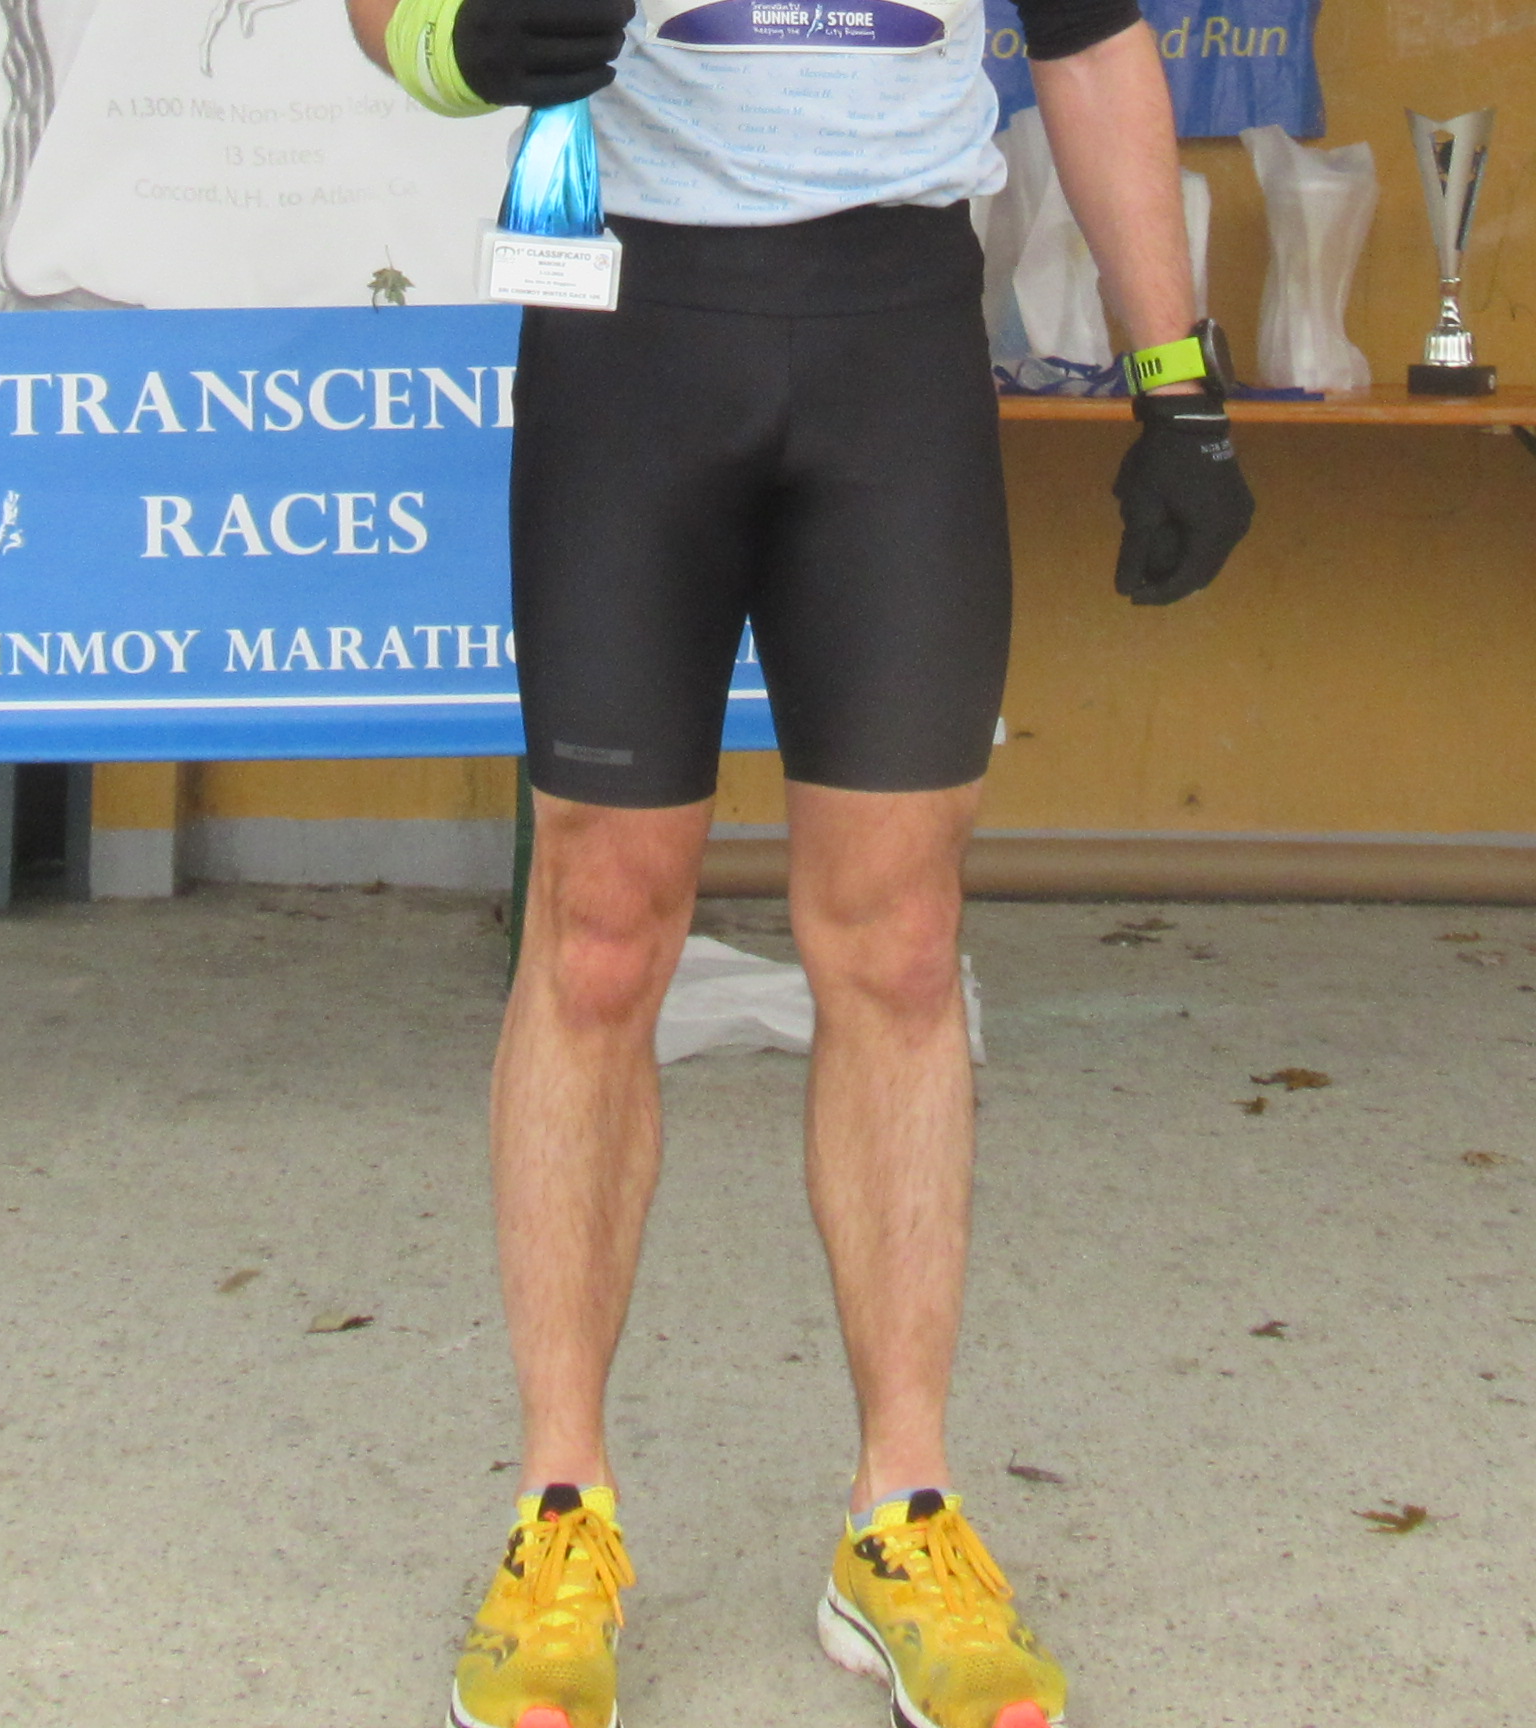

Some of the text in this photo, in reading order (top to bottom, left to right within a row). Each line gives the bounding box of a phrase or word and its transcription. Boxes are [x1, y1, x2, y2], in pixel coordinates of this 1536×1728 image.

[752, 9, 874, 27] RUNNER STORE
[1201, 16, 1289, 59] Run
[348, 93, 395, 119] elay
[252, 144, 327, 168] States
[526, 248, 592, 261] CLASSIFICATO
[140, 490, 429, 560] RACES
[224, 623, 516, 675] MARATH
